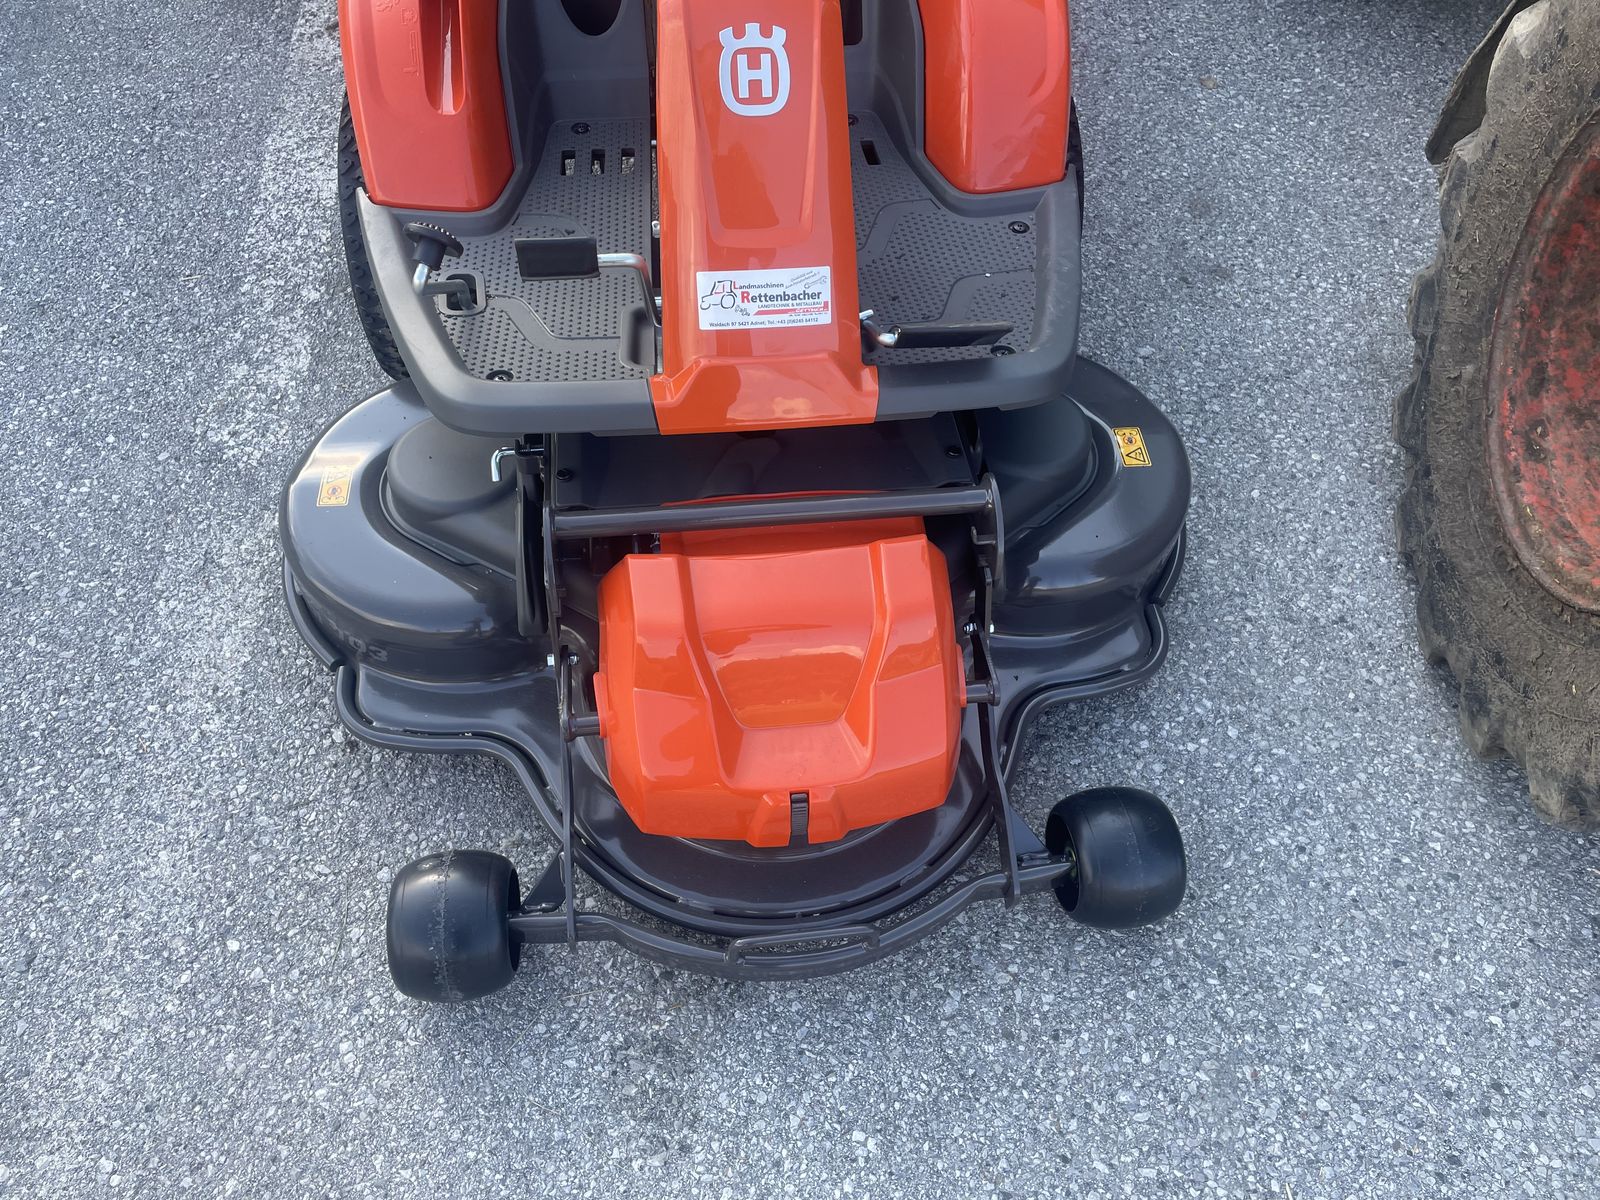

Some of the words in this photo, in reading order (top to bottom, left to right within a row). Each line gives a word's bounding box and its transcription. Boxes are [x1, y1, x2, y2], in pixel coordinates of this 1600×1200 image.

[737, 53, 772, 98] H
[733, 281, 784, 290] Landmaschinen
[741, 290, 822, 303] Rettenbacher
